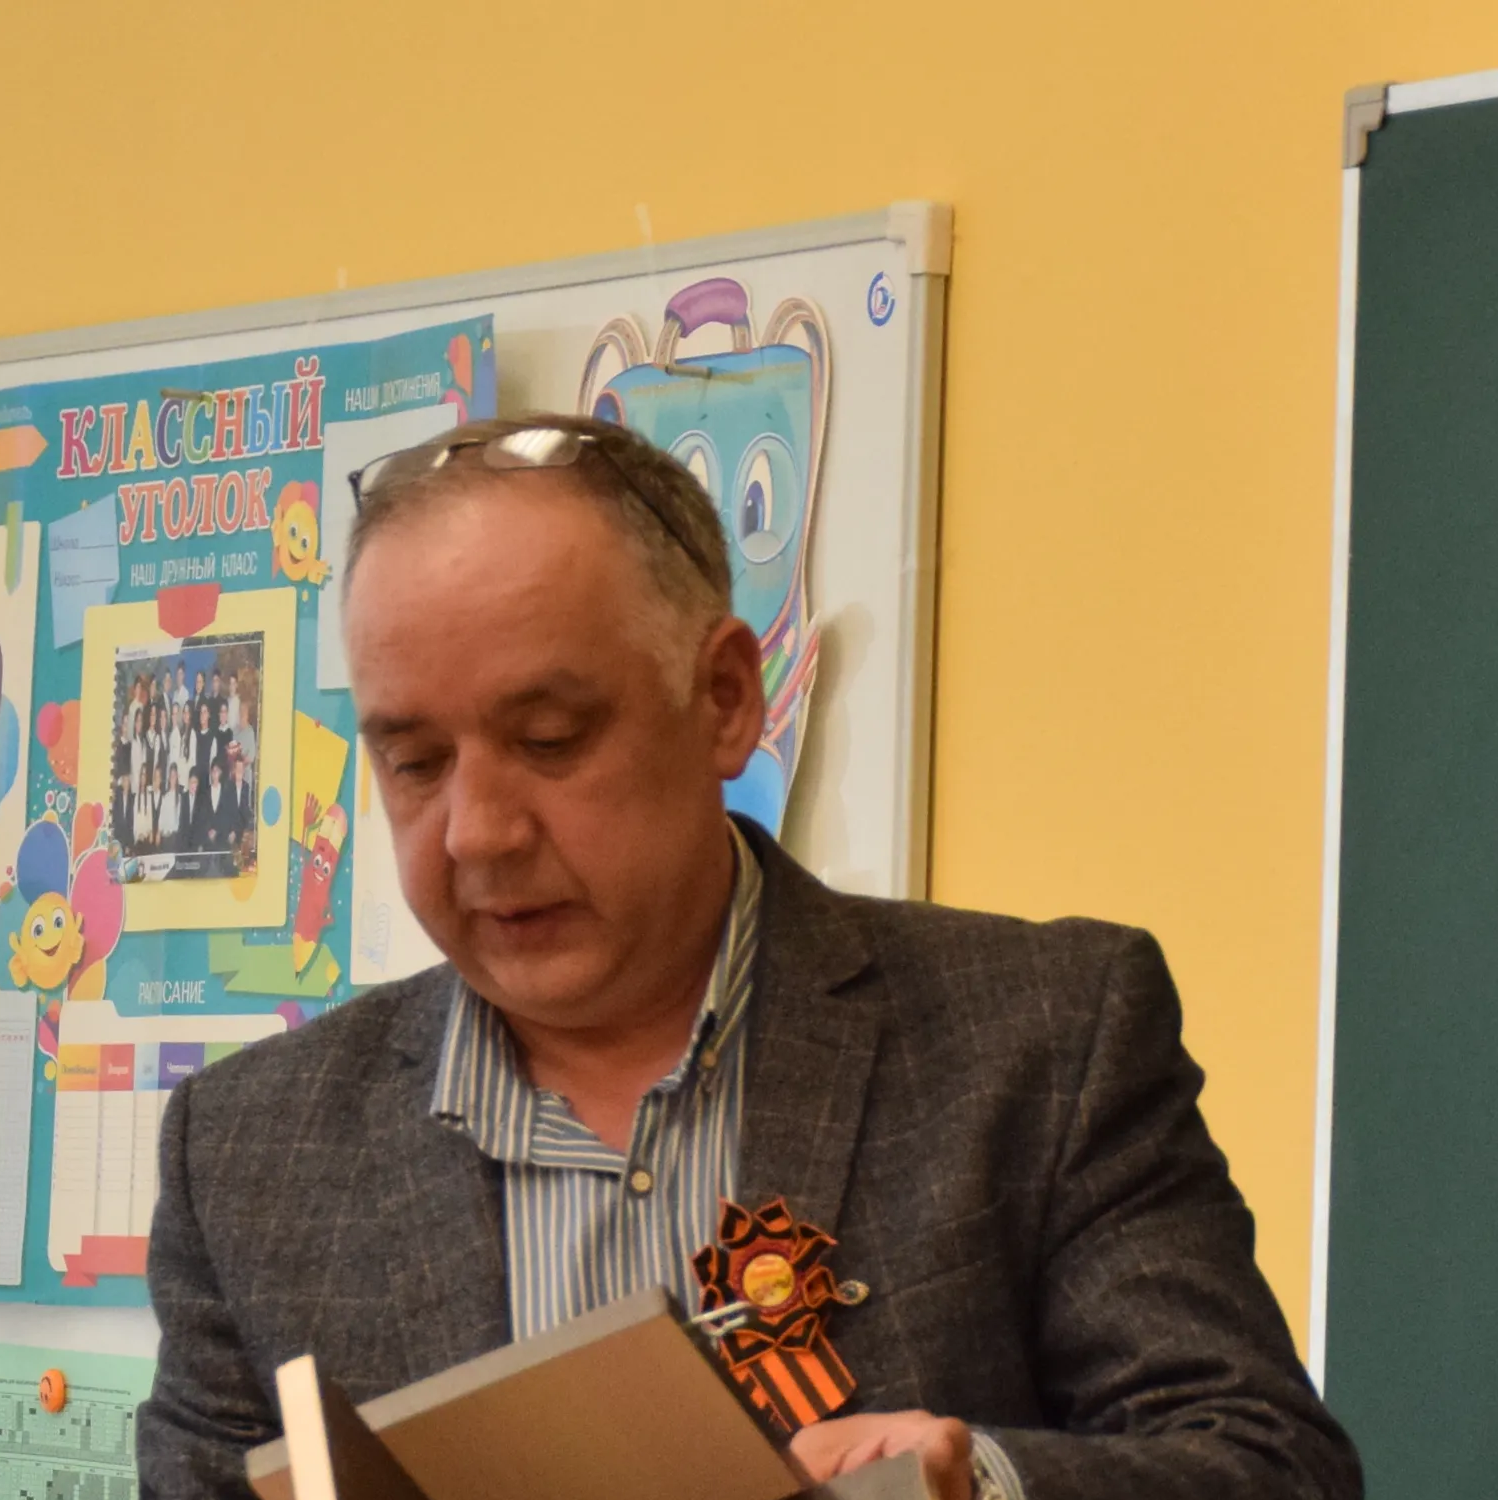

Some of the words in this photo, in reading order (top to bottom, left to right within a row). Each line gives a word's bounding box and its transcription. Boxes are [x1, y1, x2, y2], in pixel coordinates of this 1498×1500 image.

[345, 385, 379, 412] НАШИ
[57, 355, 325, 479] КЛАССНЫЙ
[118, 467, 272, 545] УГОЛОК
[130, 563, 156, 587] НАШ
[160, 552, 215, 586] ДРУЖНЫЙ
[221, 551, 259, 578] КЛАСС
[138, 980, 206, 1005] РАСПИСАНИЕ
